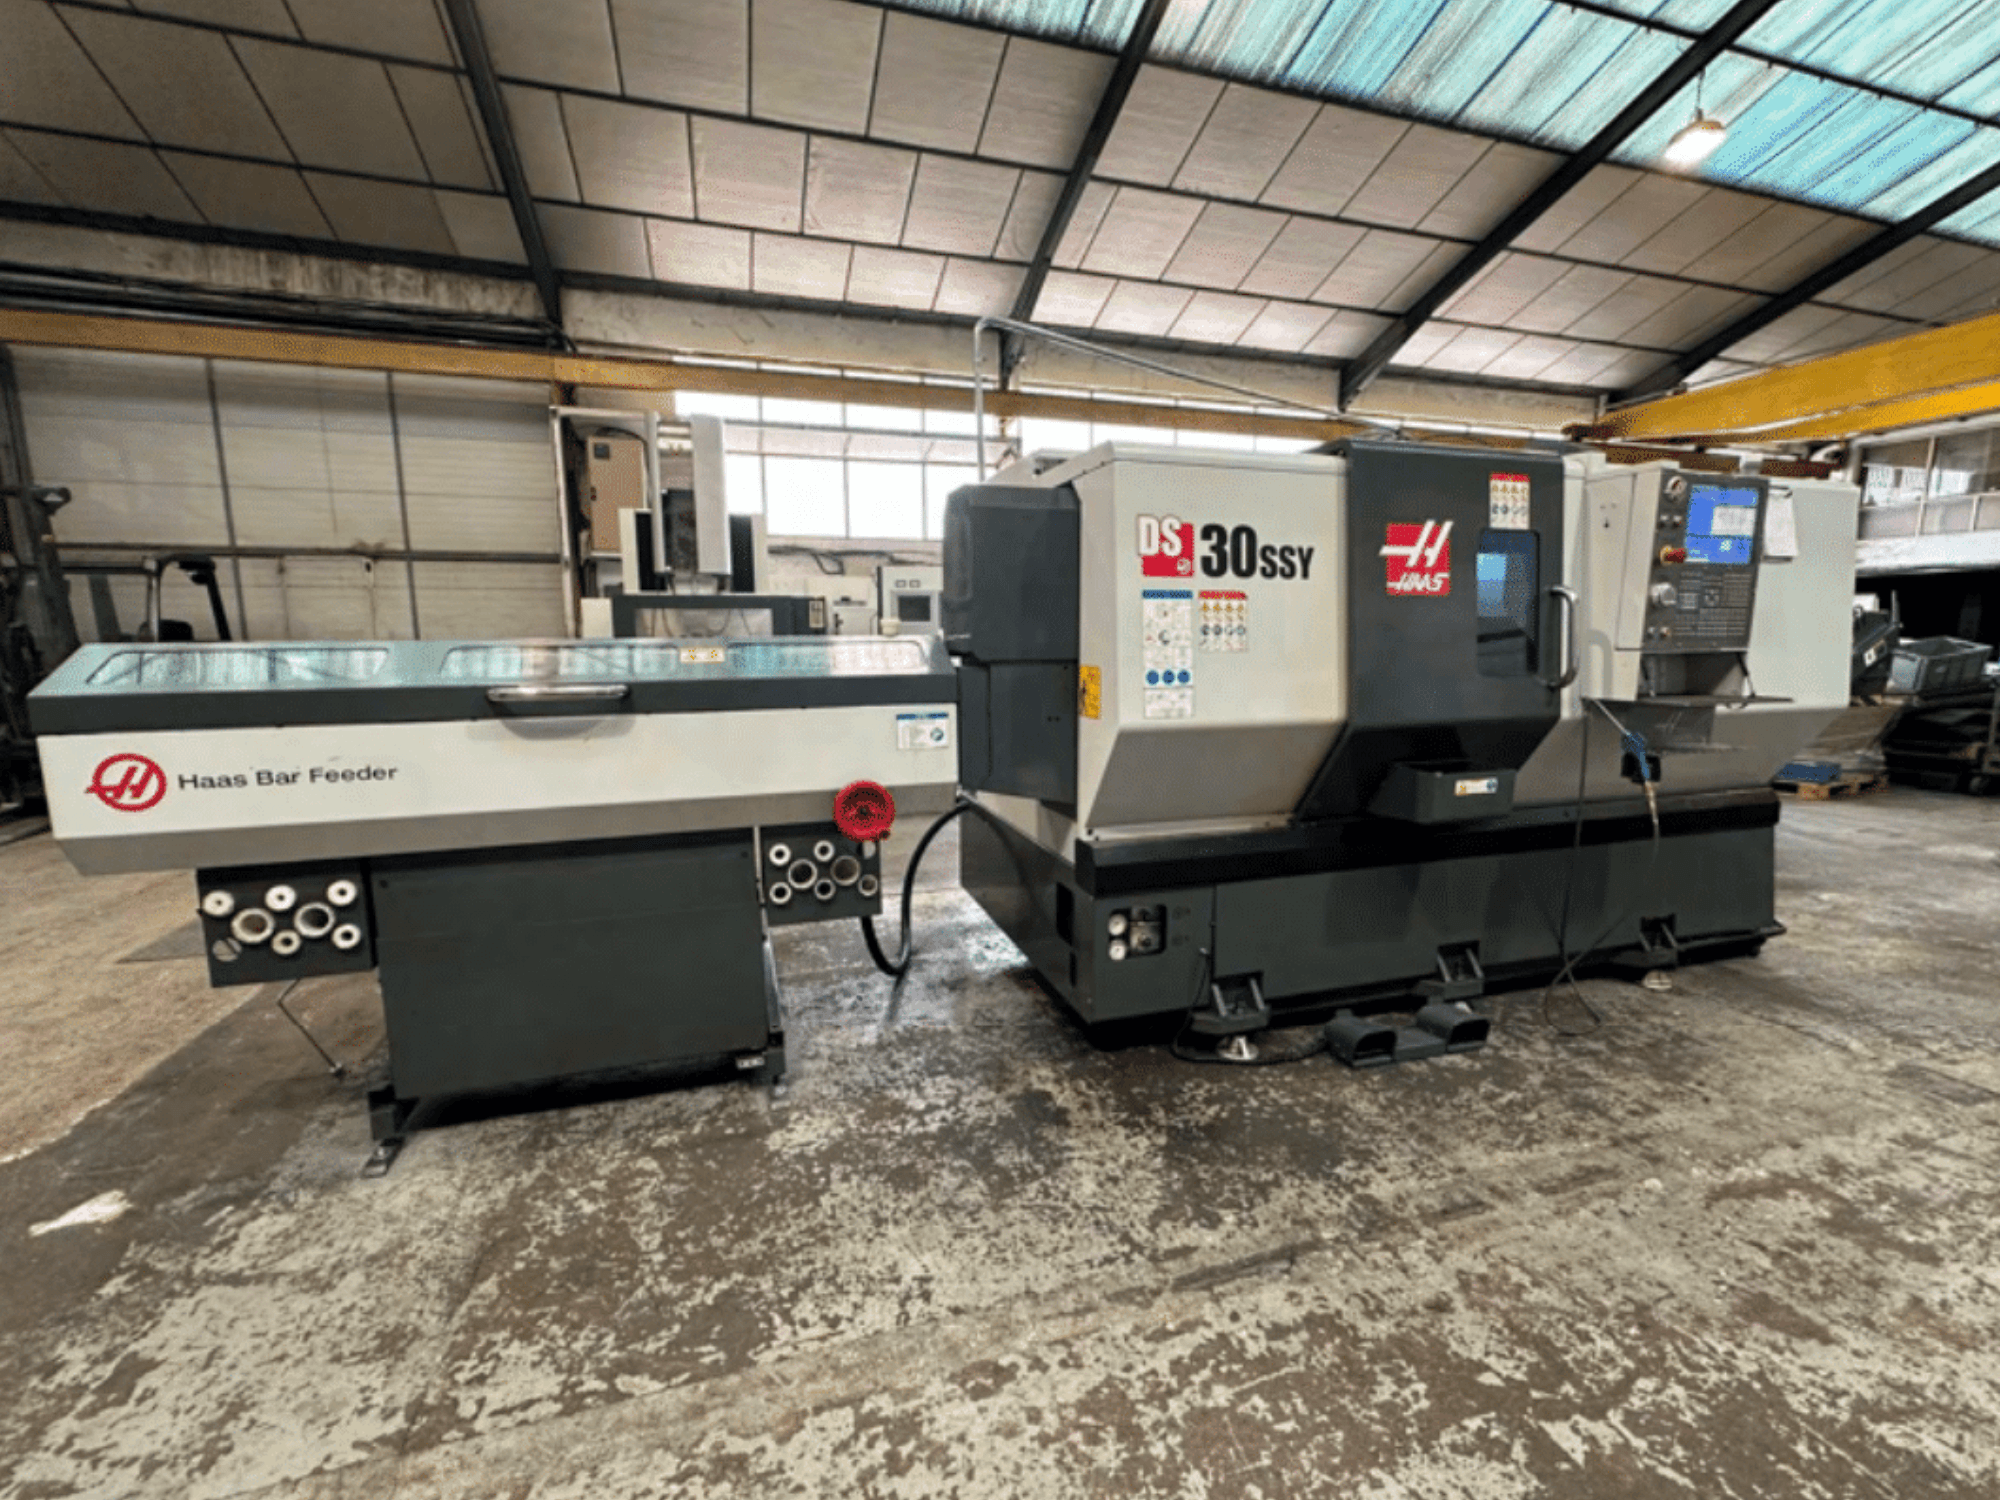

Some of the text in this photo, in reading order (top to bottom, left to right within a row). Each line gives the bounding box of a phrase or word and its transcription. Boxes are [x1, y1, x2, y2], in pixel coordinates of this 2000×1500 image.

[1137, 514, 1183, 557] DS
[1386, 572, 1451, 592] HAAS
[178, 764, 399, 790] Haas Bar Feeder
